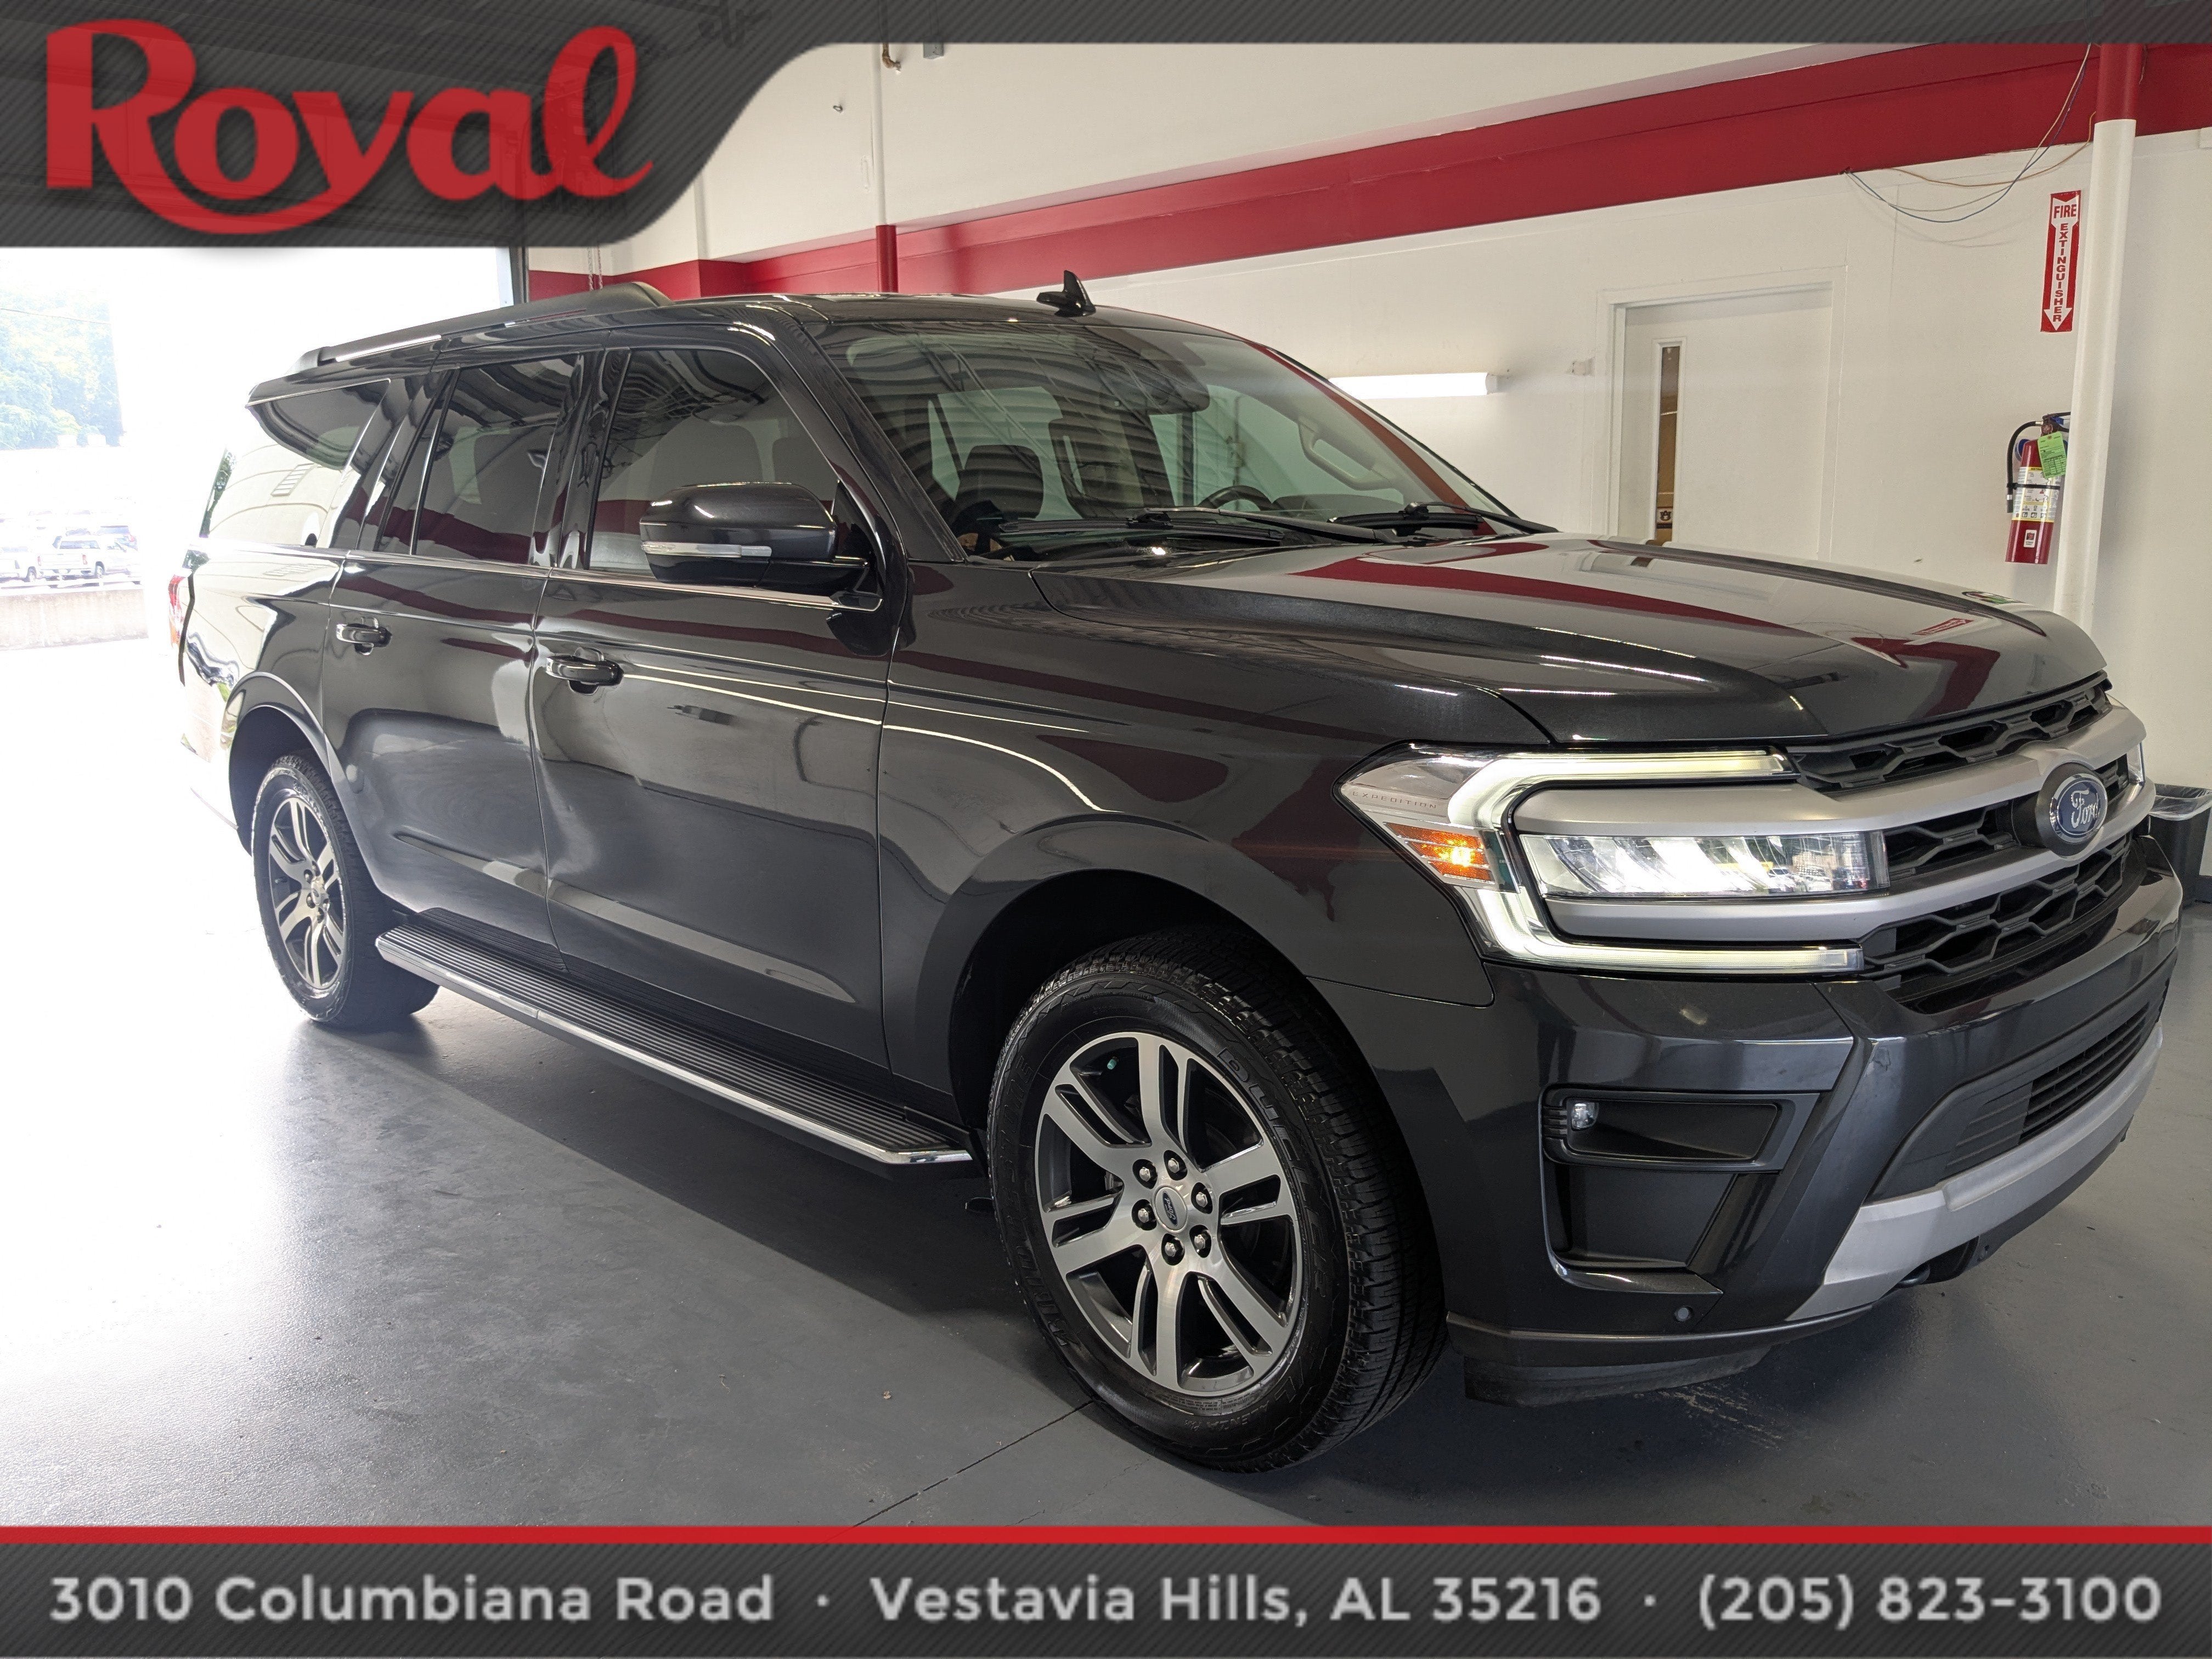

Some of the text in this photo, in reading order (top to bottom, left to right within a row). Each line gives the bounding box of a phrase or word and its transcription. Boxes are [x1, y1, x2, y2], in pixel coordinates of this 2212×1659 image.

[2053, 204, 2077, 218] FIRE
[2052, 223, 2069, 322] EXTINGUISHER
[1352, 791, 1436, 809] EXPEDITION
[2070, 787, 2100, 828] Ford
[1164, 1197, 1176, 1220] Ford
